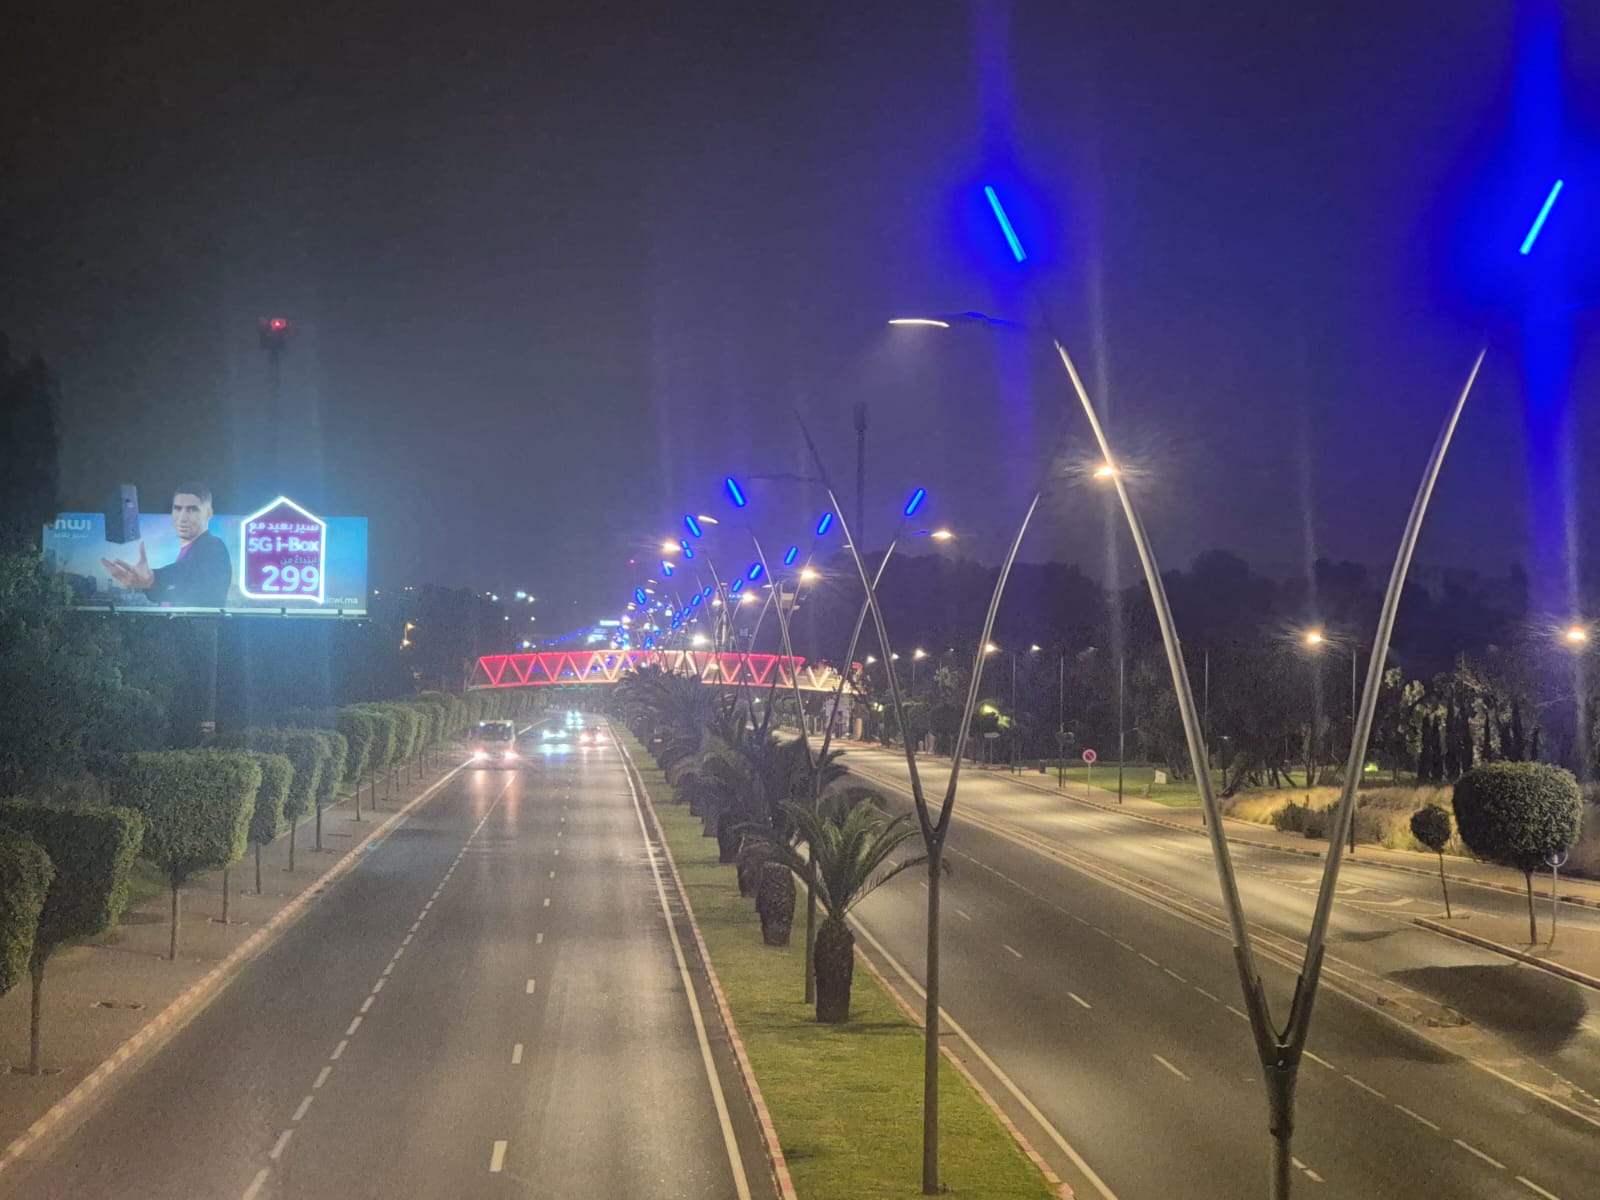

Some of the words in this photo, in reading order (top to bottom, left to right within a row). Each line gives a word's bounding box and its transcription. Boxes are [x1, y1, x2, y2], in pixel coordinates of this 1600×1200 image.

[51, 519, 91, 530] nwi
[248, 522, 266, 534] مع
[248, 537, 273, 553] 5G
[276, 536, 319, 553] i-Box
[261, 565, 320, 592] 299
